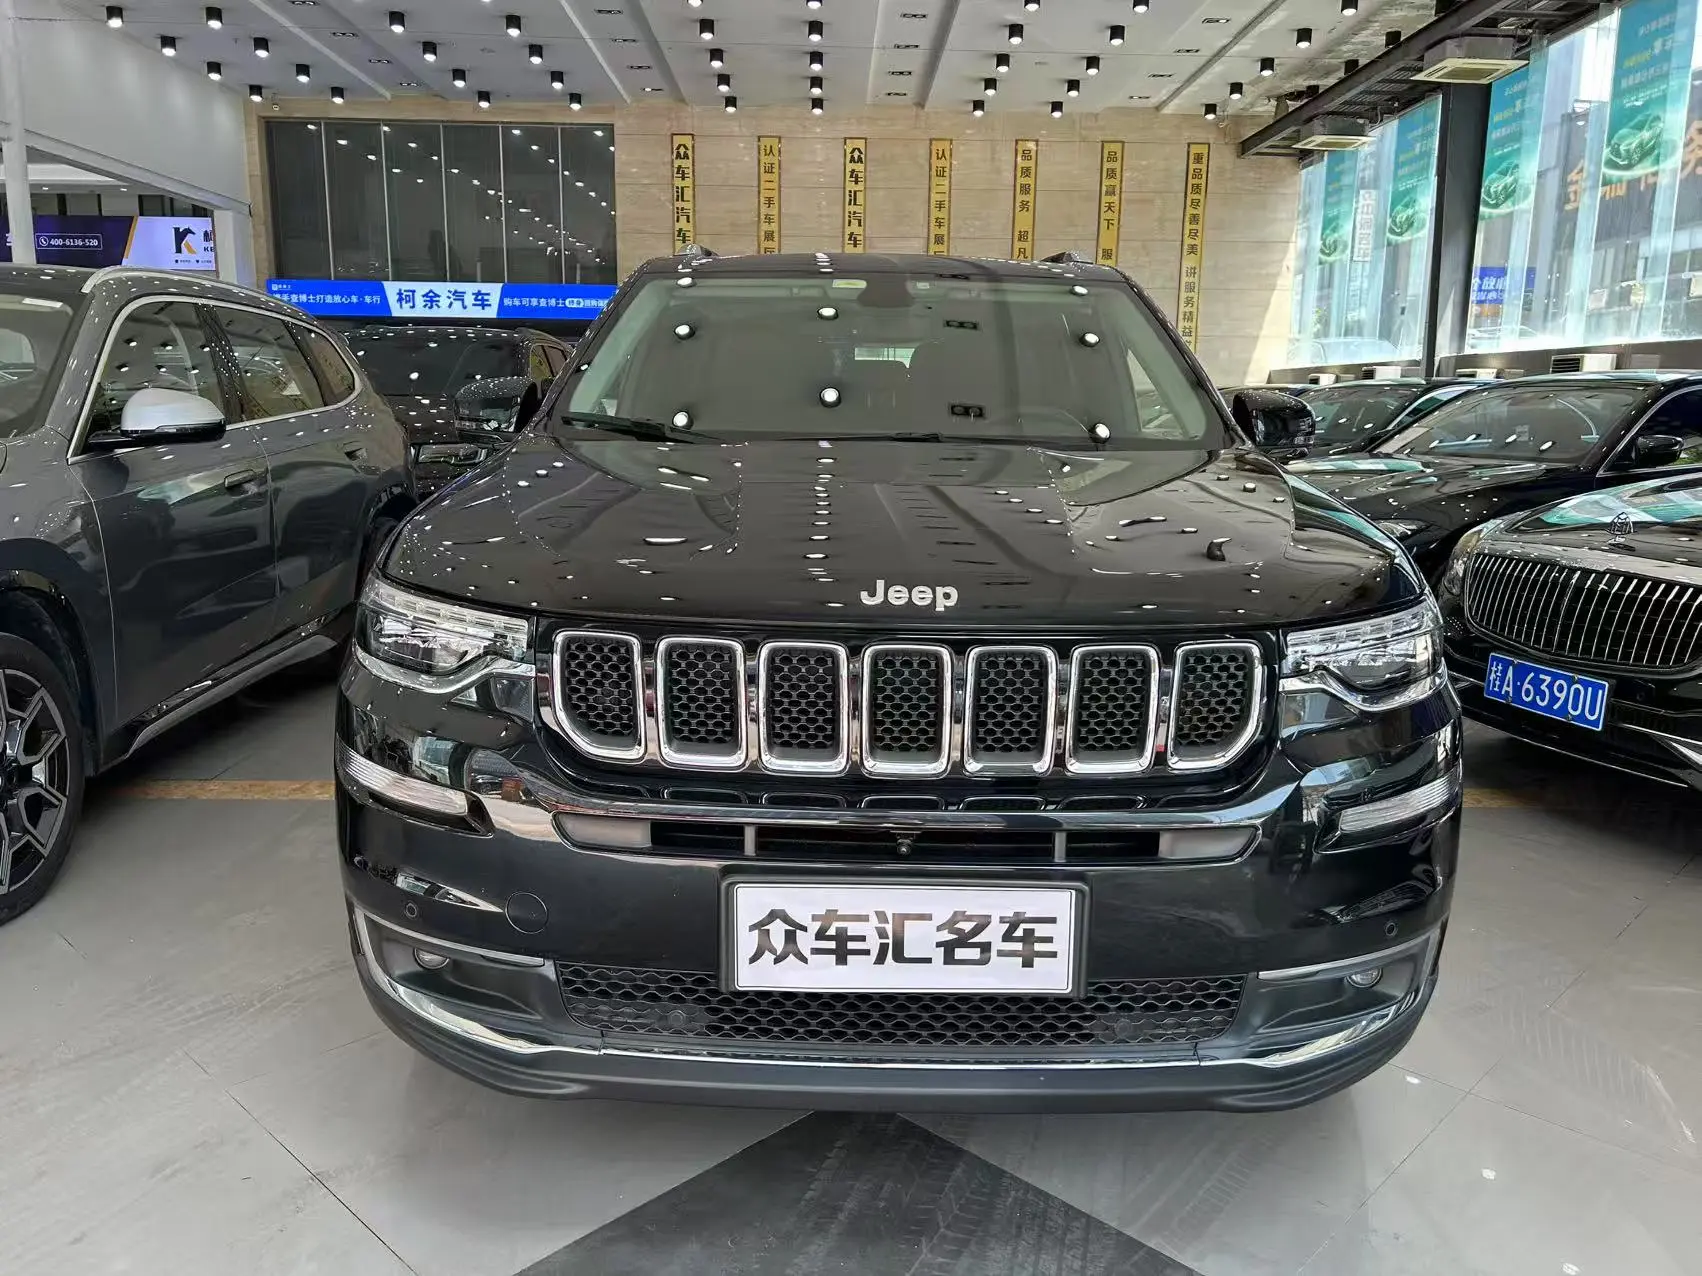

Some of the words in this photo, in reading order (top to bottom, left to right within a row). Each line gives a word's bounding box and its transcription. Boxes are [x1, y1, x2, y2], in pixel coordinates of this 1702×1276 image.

[674, 143, 691, 244] 众车汇汽车
[847, 147, 864, 249] 众车汇汽车
[1018, 149, 1033, 213] 品质服务
[1103, 151, 1118, 231] 品质赢天下
[1186, 152, 1204, 256] 重品质尽善尽美
[50, 238, 98, 247] 400-6136-520
[1016, 230, 1029, 260] 超凡
[396, 288, 493, 311] 柯余汽车
[859, 579, 959, 612] Jeep
[748, 908, 1058, 969] 众车汇名车
